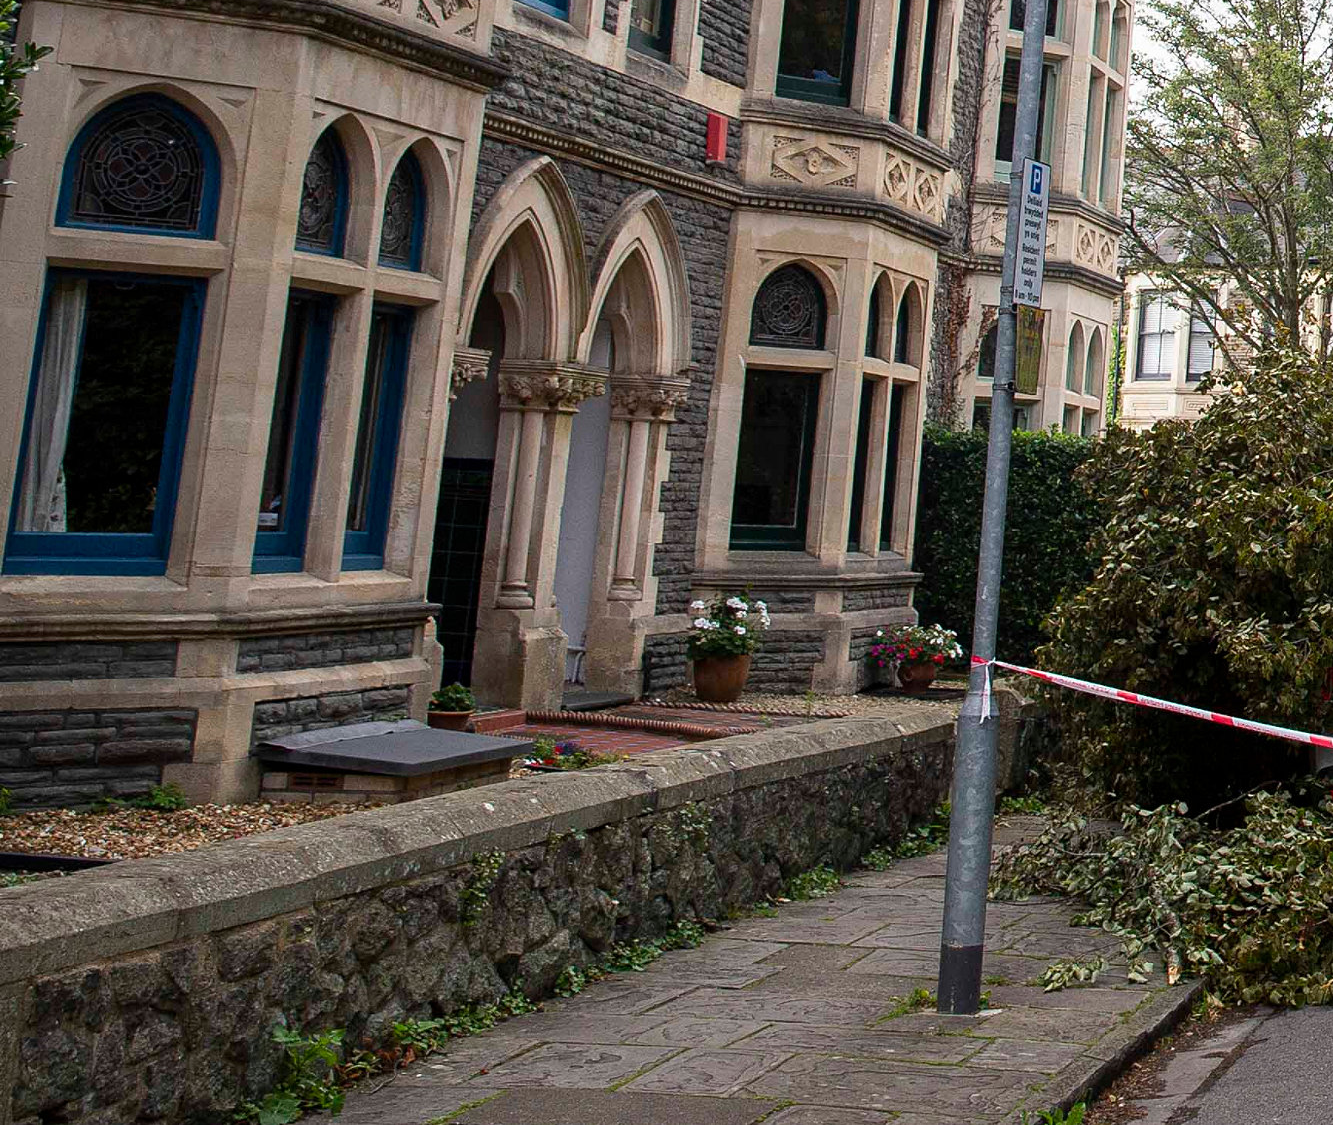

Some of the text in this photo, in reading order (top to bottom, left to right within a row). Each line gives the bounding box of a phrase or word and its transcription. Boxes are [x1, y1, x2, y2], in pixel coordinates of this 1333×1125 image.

[1034, 170, 1040, 190] P
[1022, 243, 1040, 256] Resident
[1023, 256, 1037, 268] permit
[1021, 266, 1037, 278] holders
[1024, 278, 1032, 289] only
